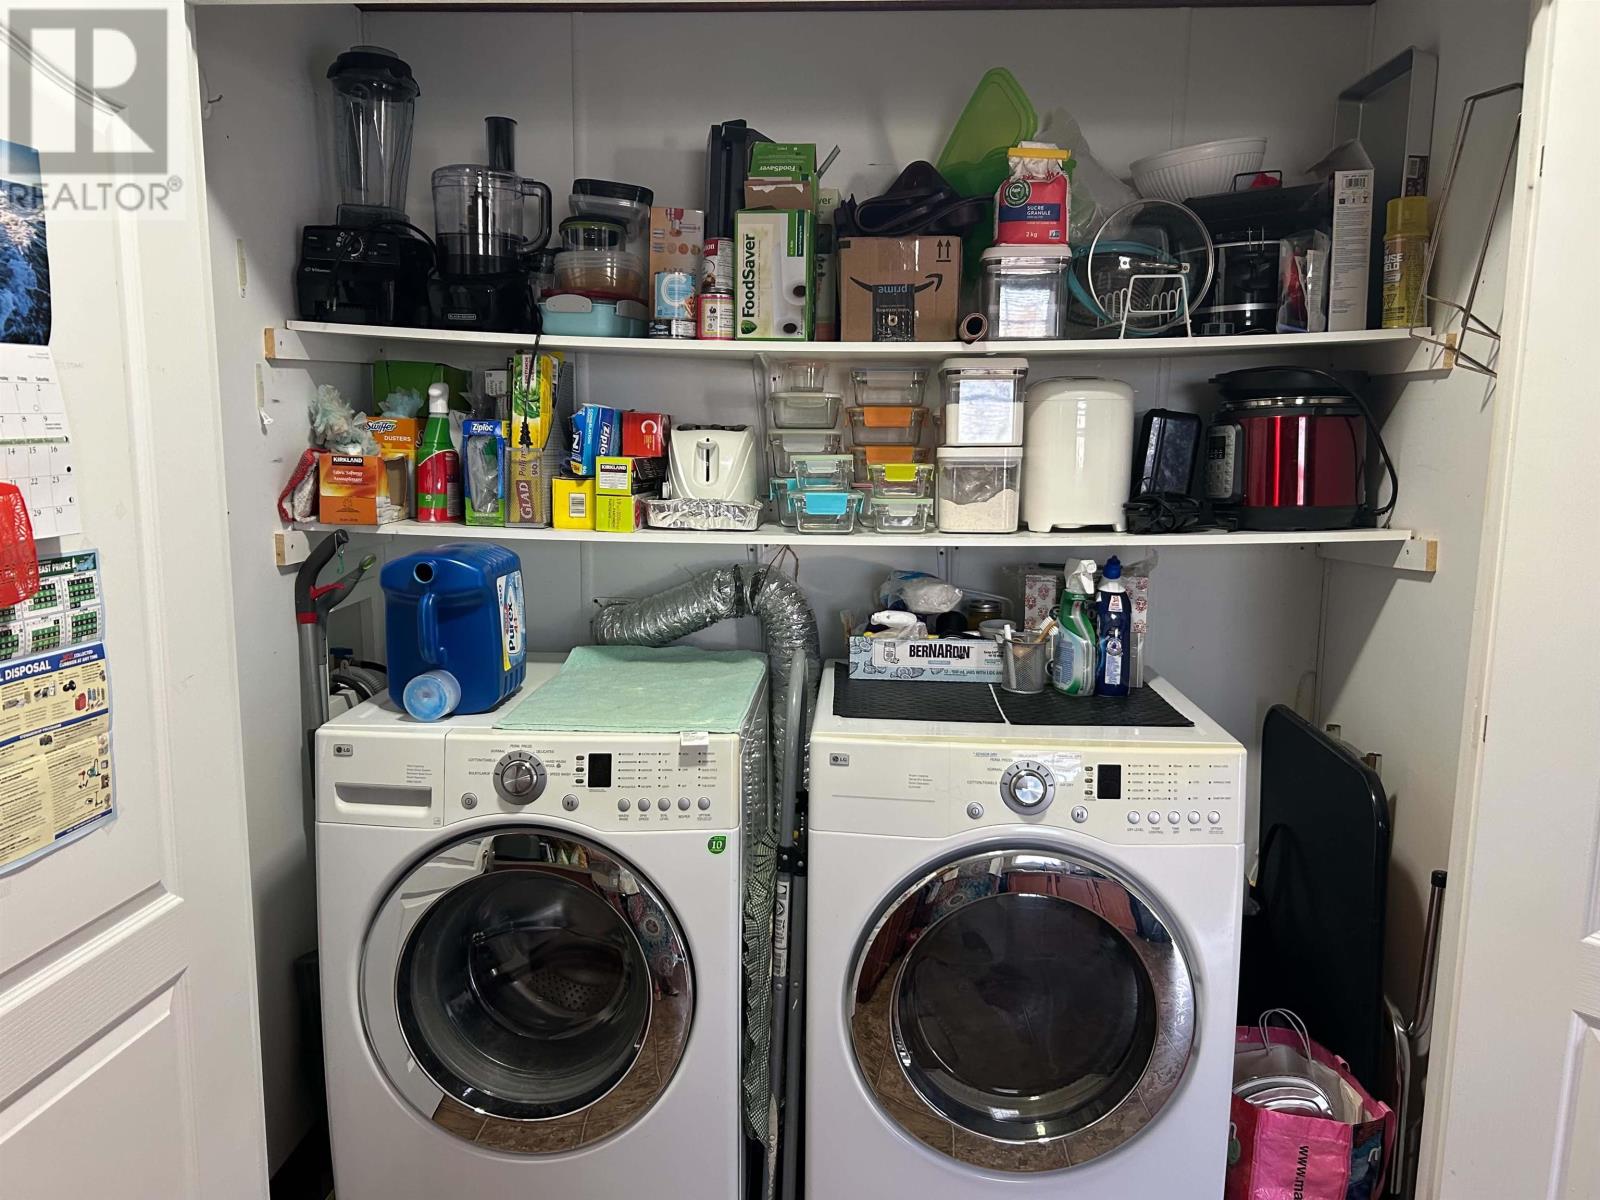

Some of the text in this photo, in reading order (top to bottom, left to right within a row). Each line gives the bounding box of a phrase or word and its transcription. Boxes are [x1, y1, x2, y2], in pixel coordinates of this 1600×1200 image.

[742, 233, 756, 318] FoodSaver
[878, 284, 908, 296] prime
[365, 421, 397, 431] Swiffer
[472, 423, 494, 432] Ziploc
[600, 424, 611, 456] Ziplo
[7, 447, 15, 455] 14
[30, 477, 38, 485] 22
[52, 476, 59, 484] 23
[518, 482, 533, 519] GLAD
[33, 507, 63, 517] 29 30
[38, 561, 72, 574] EAST PRINCE
[909, 643, 970, 660] BERNARDIN
[5, 659, 52, 680] DISPOSAL
[711, 840, 723, 850] 10
